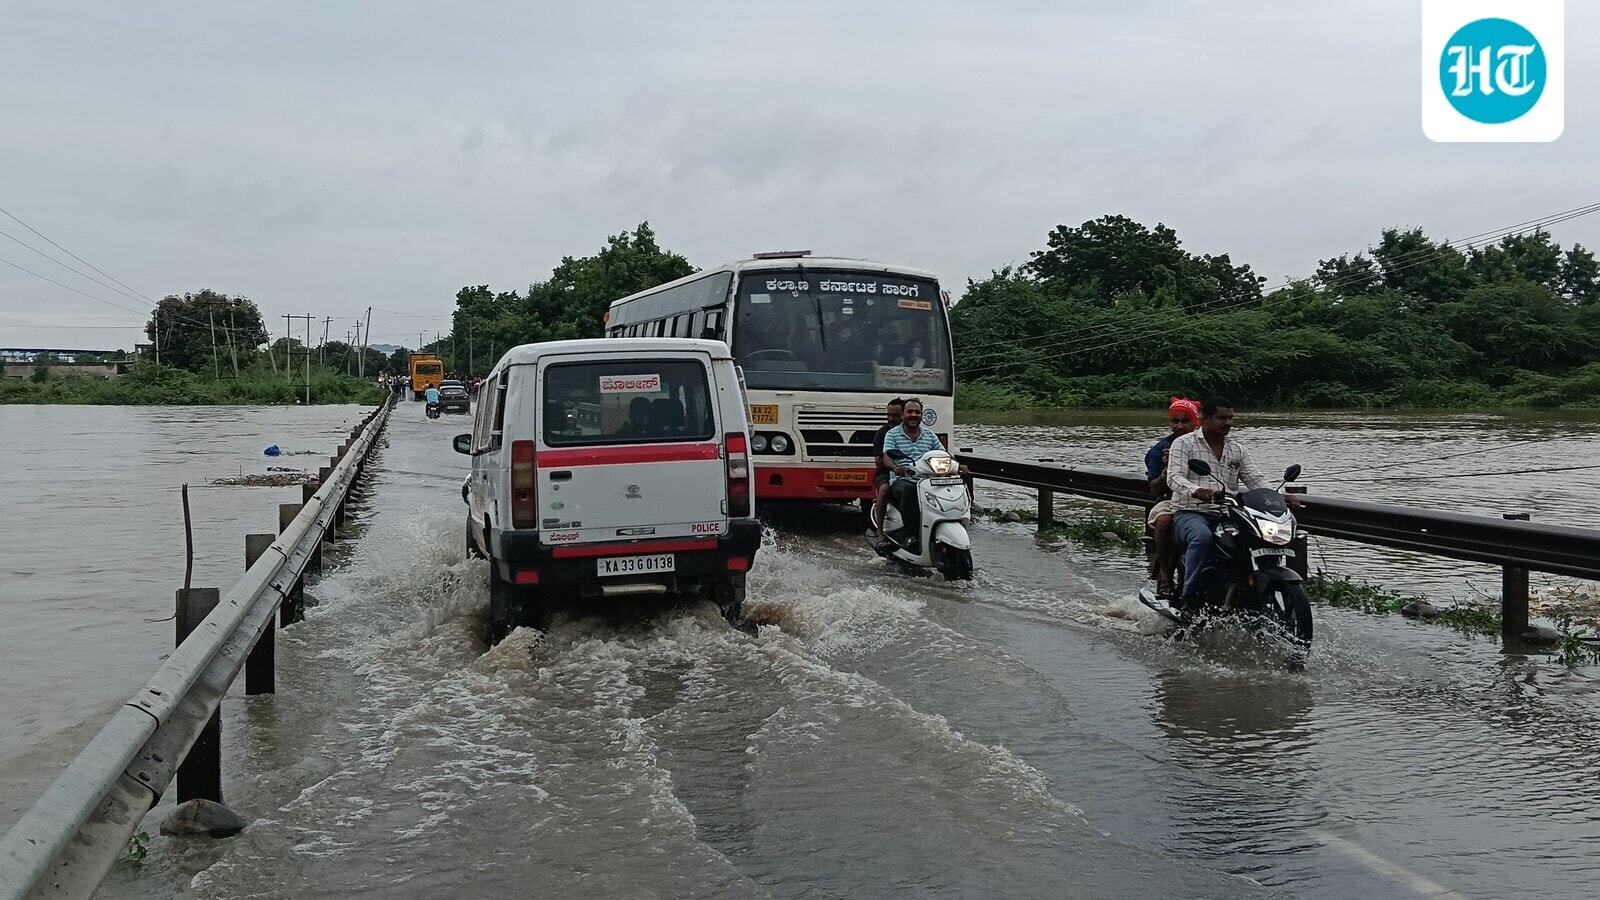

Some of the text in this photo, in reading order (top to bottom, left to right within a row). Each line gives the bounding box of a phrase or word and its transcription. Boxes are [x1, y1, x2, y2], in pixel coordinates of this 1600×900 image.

[766, 278, 919, 298] ಕಲ್ಯಾಣ ಕರ್ನಾಟಕ ಸಾರಿಗೆ
[763, 406, 772, 414] 32
[691, 523, 720, 533] POLICE
[605, 556, 673, 573] KA 33 G 0138
